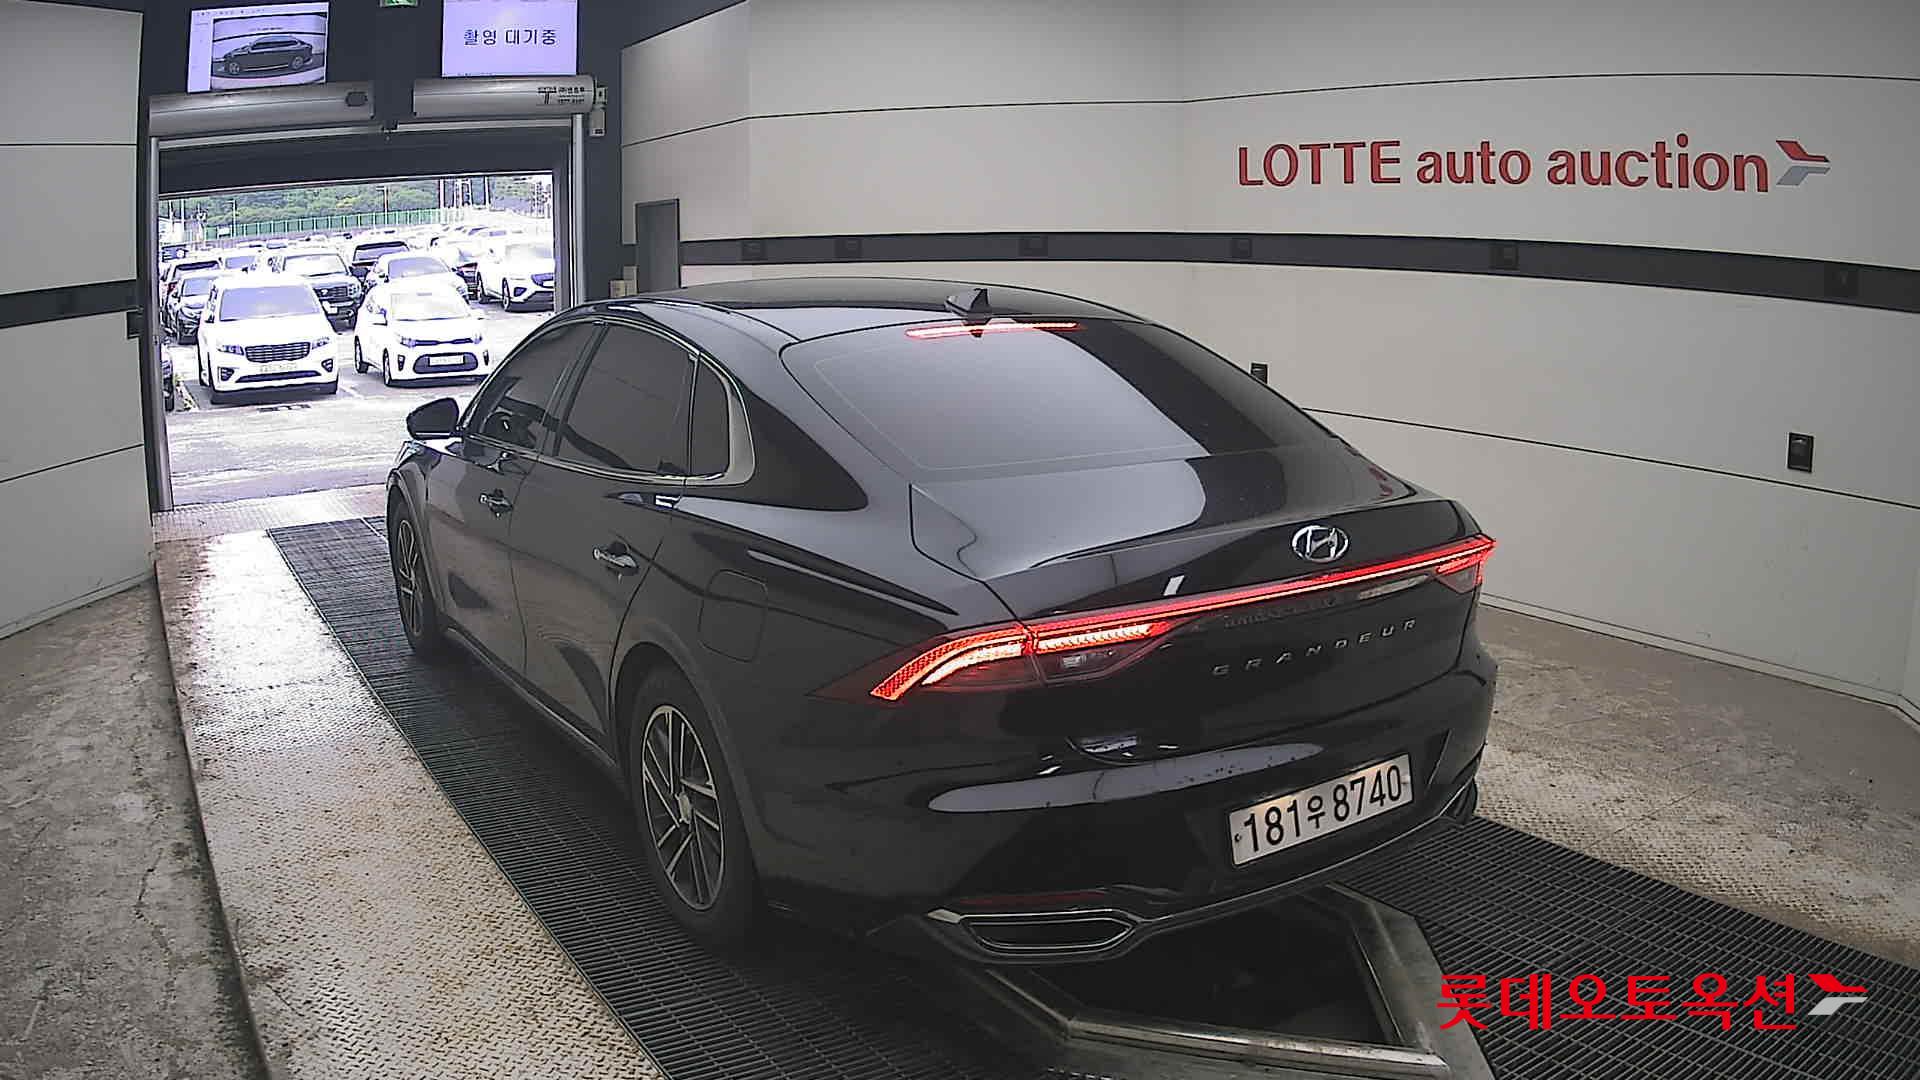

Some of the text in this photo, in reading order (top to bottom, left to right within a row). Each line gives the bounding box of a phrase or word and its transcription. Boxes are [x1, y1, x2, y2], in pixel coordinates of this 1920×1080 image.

[505, 29, 557, 46] 대기중
[1239, 133, 1770, 194] LOTTE auto auction
[1212, 618, 1415, 676] GRANDEUR
